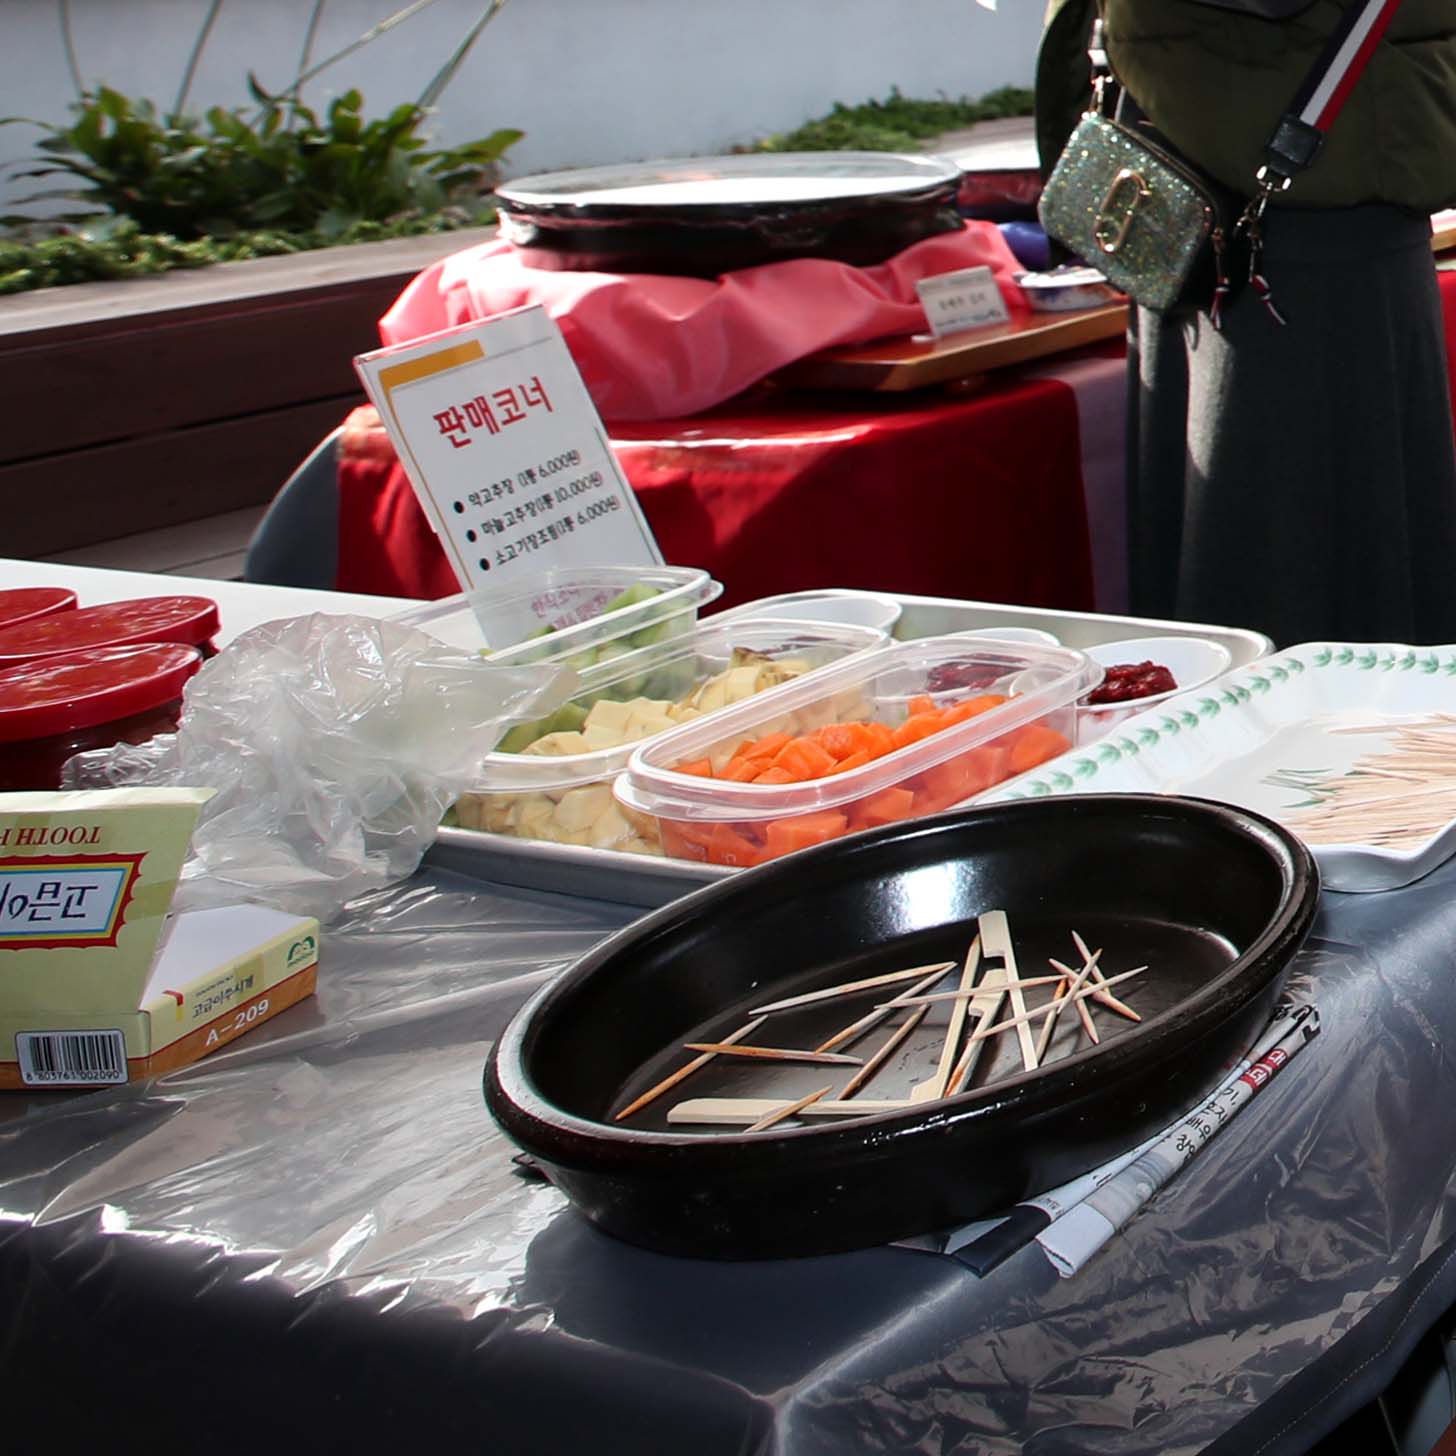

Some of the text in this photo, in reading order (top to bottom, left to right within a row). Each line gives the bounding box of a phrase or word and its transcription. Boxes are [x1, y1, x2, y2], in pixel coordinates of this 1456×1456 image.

[433, 376, 553, 448] 판매코너
[468, 478, 514, 507] 약고추장
[15, 826, 102, 846] TOOTH
[205, 998, 270, 1046] A-209
